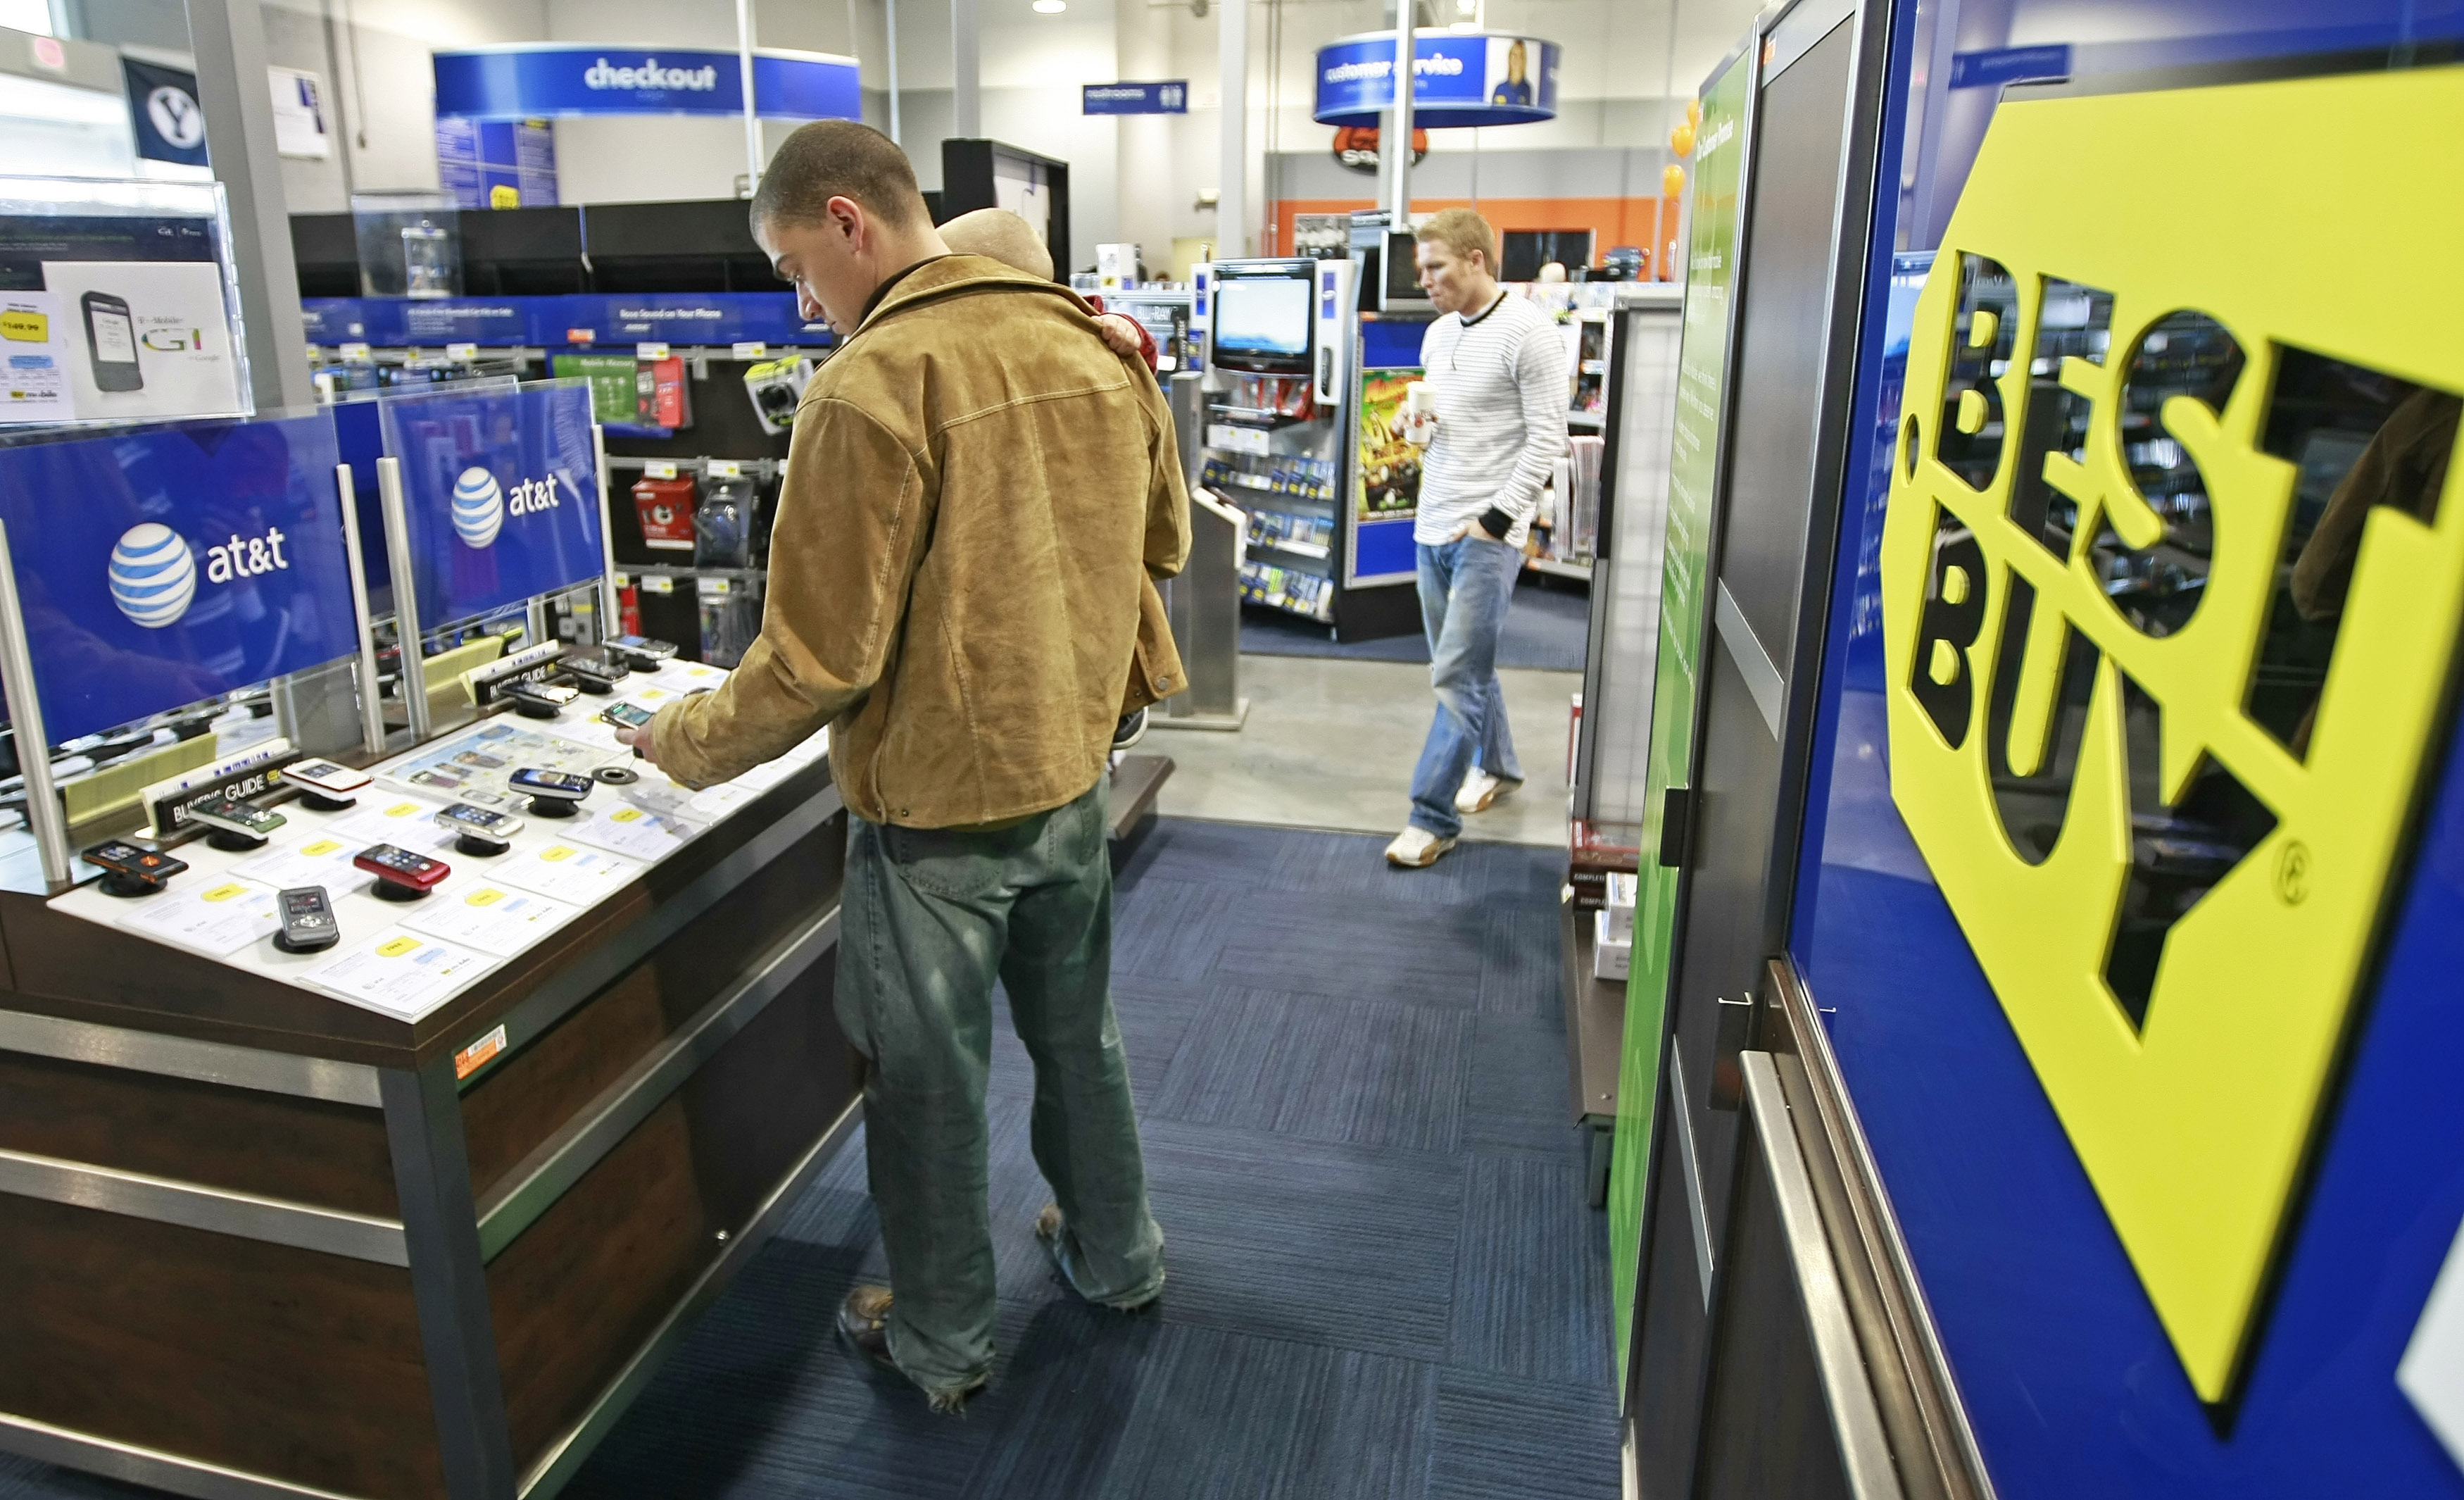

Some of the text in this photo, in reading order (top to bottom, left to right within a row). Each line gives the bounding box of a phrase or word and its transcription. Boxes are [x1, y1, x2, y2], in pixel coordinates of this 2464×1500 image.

[584, 57, 717, 92] checkout
[1325, 53, 1464, 83] customer rvice
[639, 308, 664, 319] Sound
[510, 473, 560, 517] at&t
[1932, 249, 2464, 769] BEST
[208, 526, 289, 584] at&t
[521, 665, 546, 683] GUIDE
[225, 773, 265, 801] GUIDE
[1906, 497, 2282, 1042] BUY
